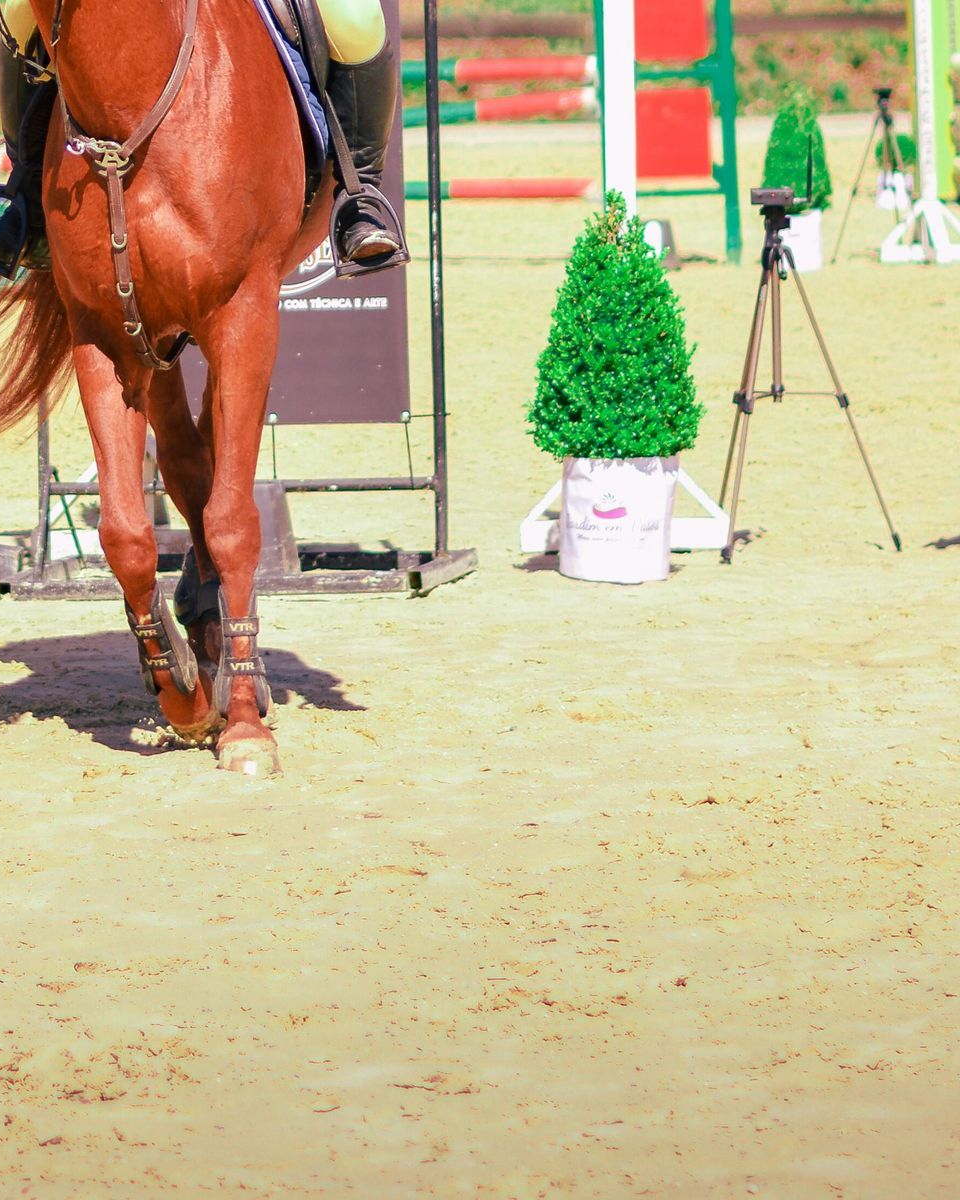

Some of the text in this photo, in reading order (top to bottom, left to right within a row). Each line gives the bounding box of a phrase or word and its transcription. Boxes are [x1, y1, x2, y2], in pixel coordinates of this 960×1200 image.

[284, 297, 387, 309] COM TÉCNICA E ARTE
[229, 623, 254, 632] VTR
[135, 629, 158, 637] VTR
[145, 658, 168, 666] VTR
[230, 662, 255, 671] VTR
